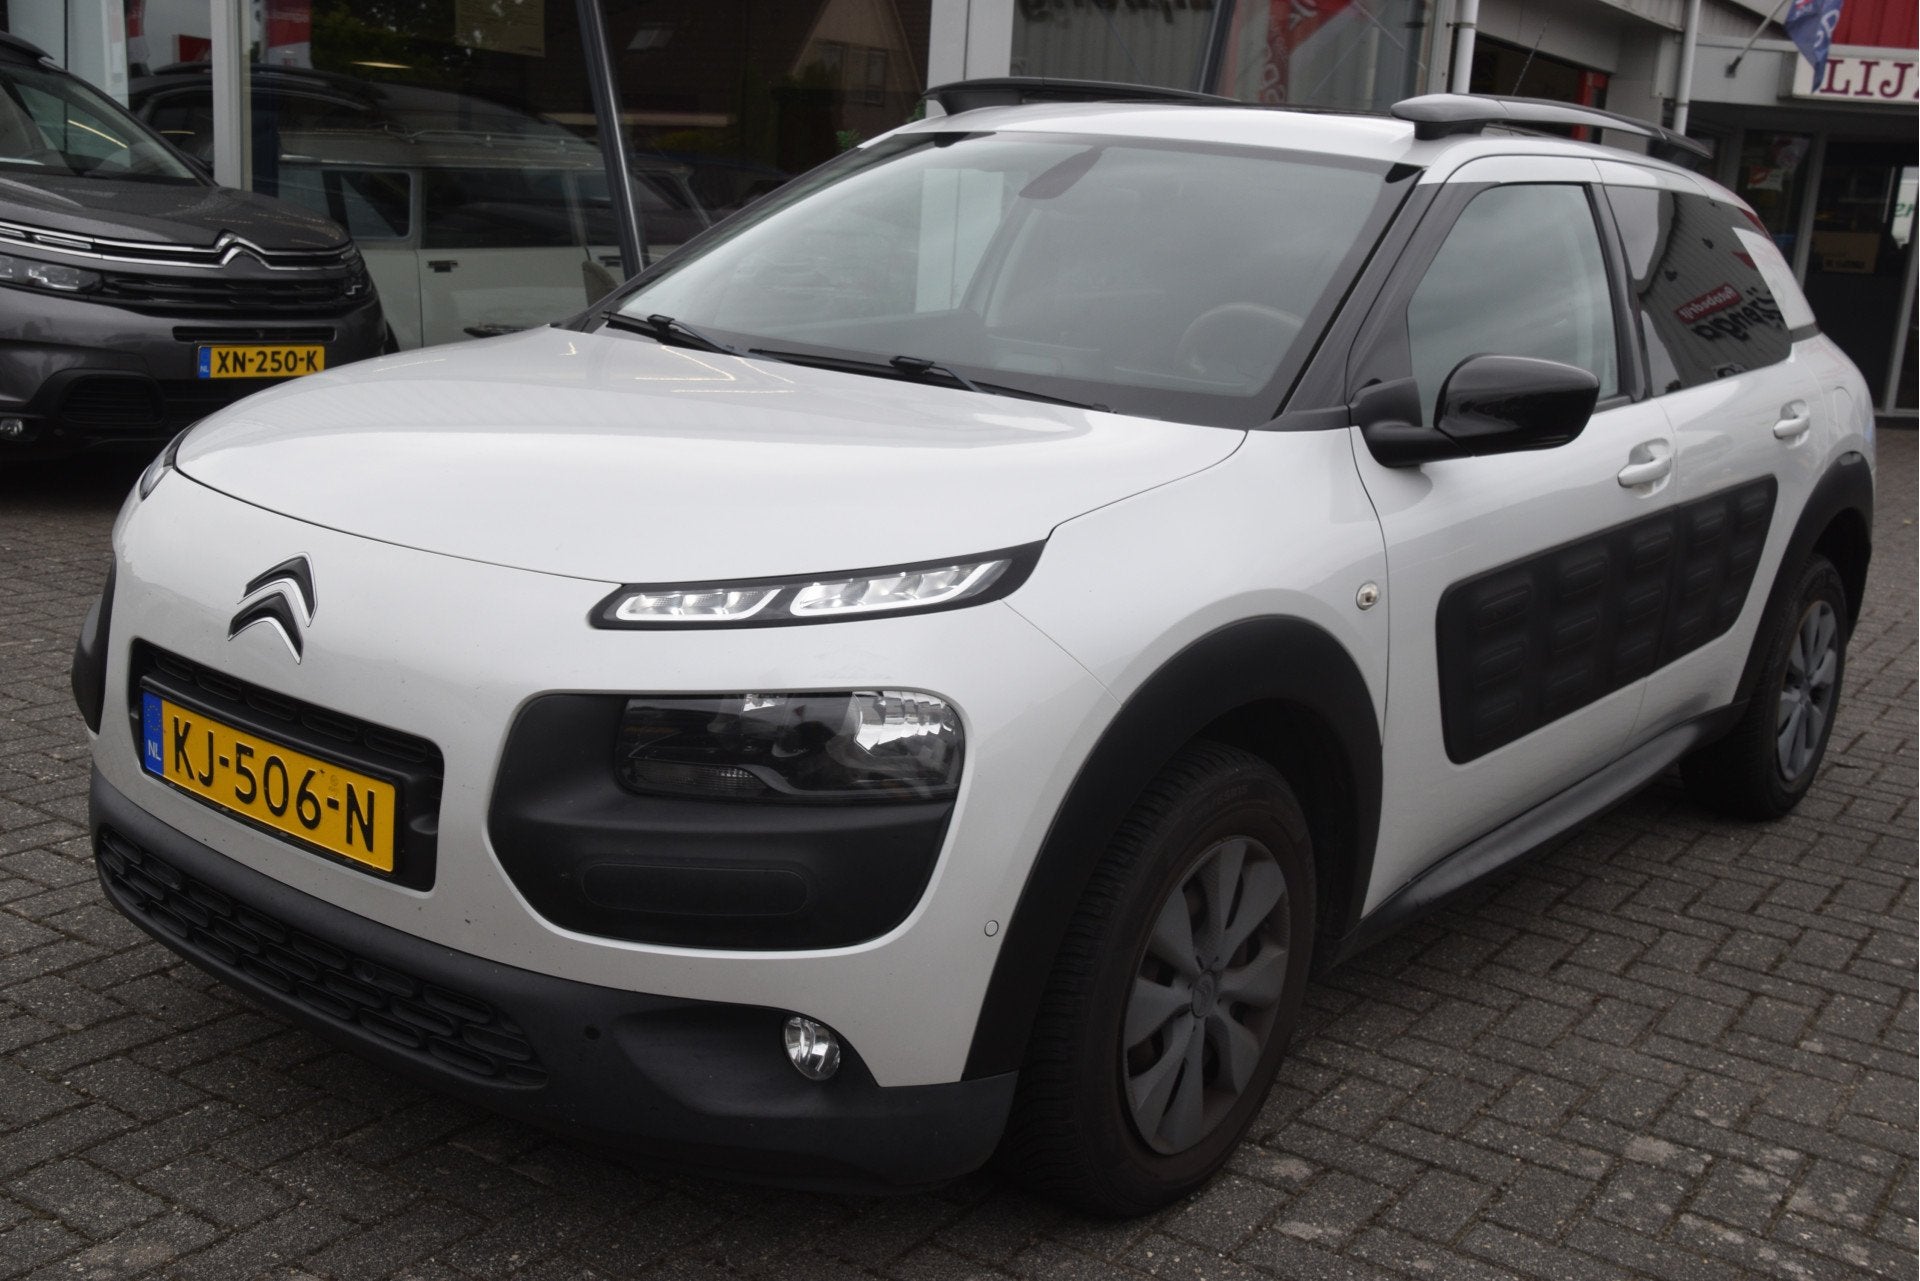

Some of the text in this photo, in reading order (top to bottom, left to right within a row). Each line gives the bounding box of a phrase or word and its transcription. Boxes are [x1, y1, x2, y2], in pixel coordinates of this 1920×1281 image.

[1819, 58, 1918, 99] LIJ
[217, 350, 319, 373] XN-250-K
[148, 715, 375, 853] NL KJ-506-N
